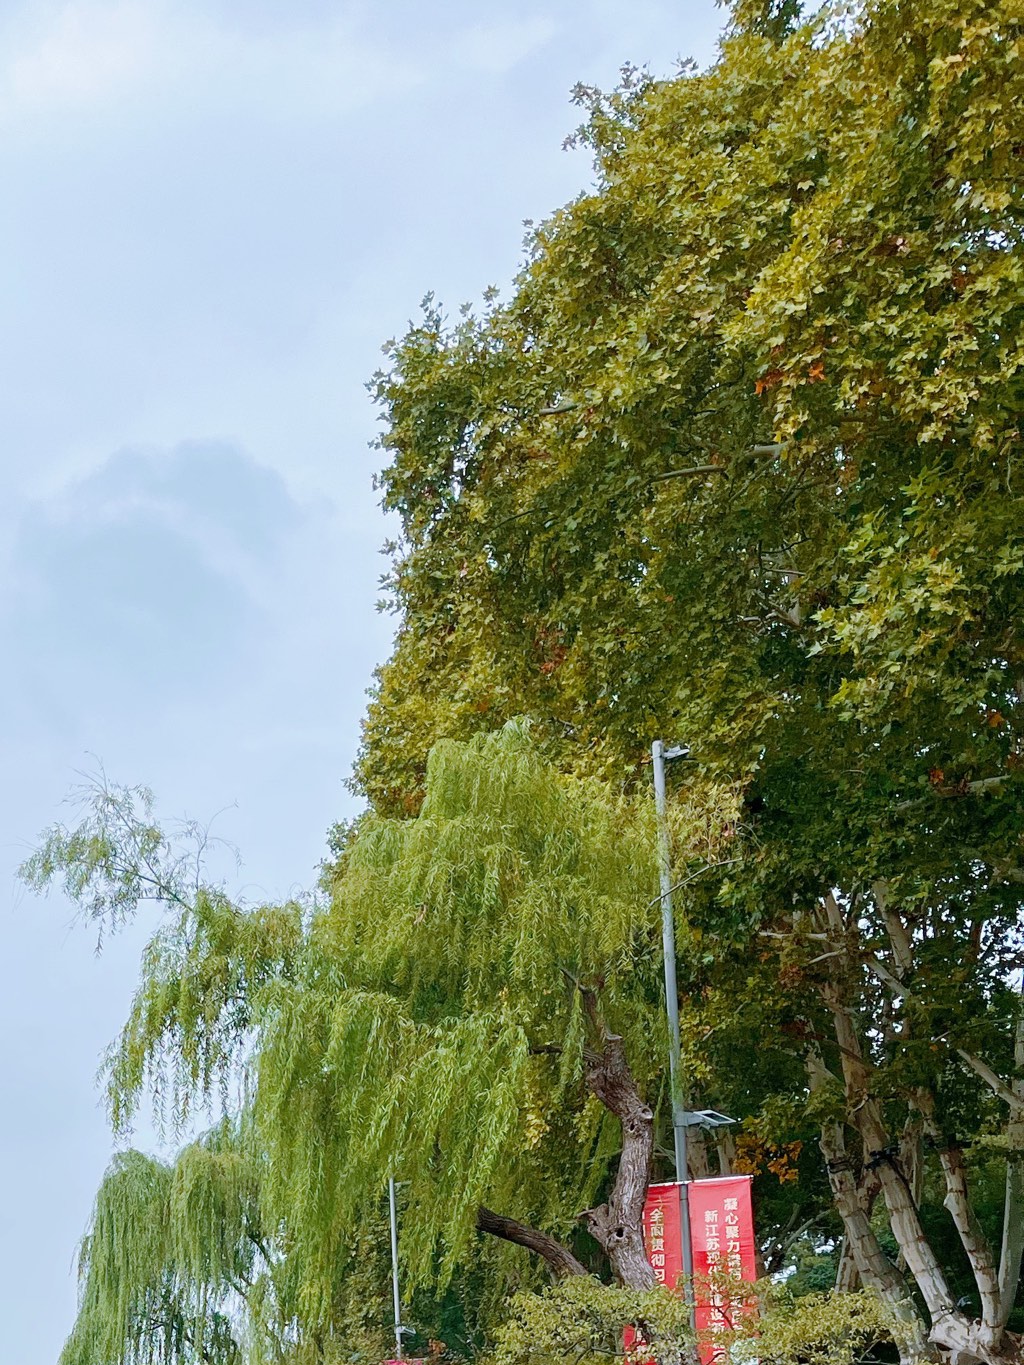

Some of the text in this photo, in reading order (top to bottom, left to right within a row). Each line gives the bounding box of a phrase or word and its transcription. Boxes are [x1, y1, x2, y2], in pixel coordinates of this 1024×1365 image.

[649, 1208, 666, 1287] 全面贯彻习
